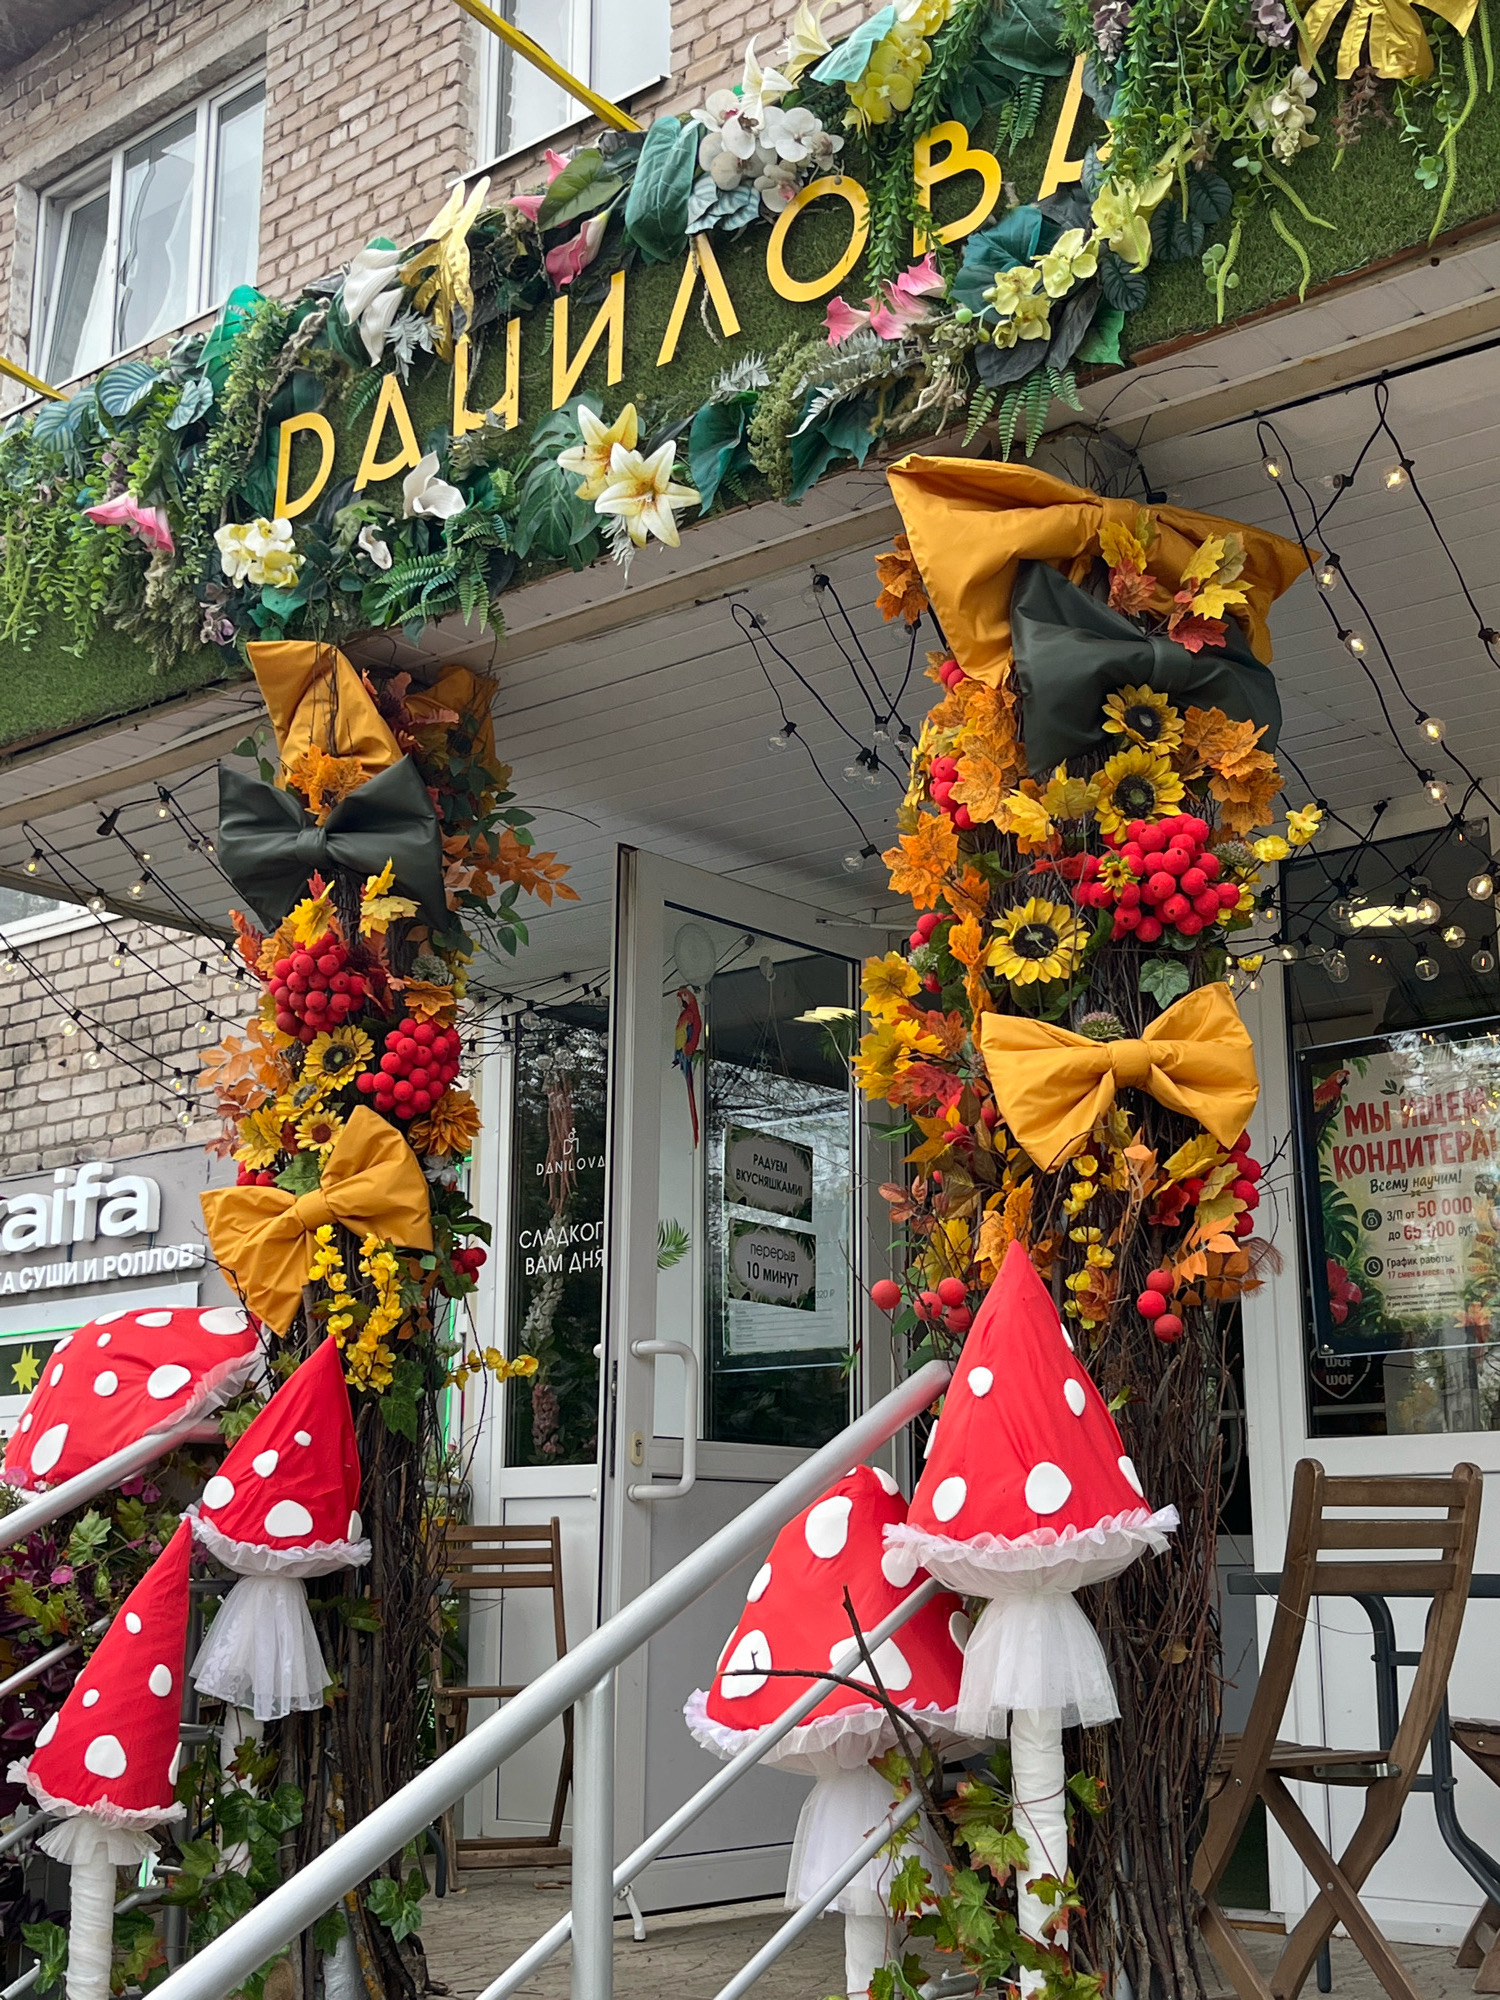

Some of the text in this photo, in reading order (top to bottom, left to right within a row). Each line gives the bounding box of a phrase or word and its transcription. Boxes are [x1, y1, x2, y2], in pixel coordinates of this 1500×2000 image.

[1344, 1101, 1392, 1137] МЫ
[536, 1155, 605, 1176] DANILOVA
[753, 1153, 788, 1174] РАДУЕМ
[1370, 1169, 1462, 1194] Всему научим!
[0, 1162, 157, 1253] aifa
[1405, 1210, 1415, 1219] от
[1417, 1200, 1437, 1218] 50
[1441, 1196, 1472, 1216] 000
[1388, 1231, 1401, 1241] до
[750, 1242, 796, 1263] перерыв
[1386, 1257, 1418, 1269] График
[20, 1260, 79, 1291] СУШИ
[83, 1257, 99, 1283] И
[103, 1244, 195, 1279] РОЛЛОВ
[525, 1254, 563, 1276] ВАМ
[746, 1261, 760, 1280] 10
